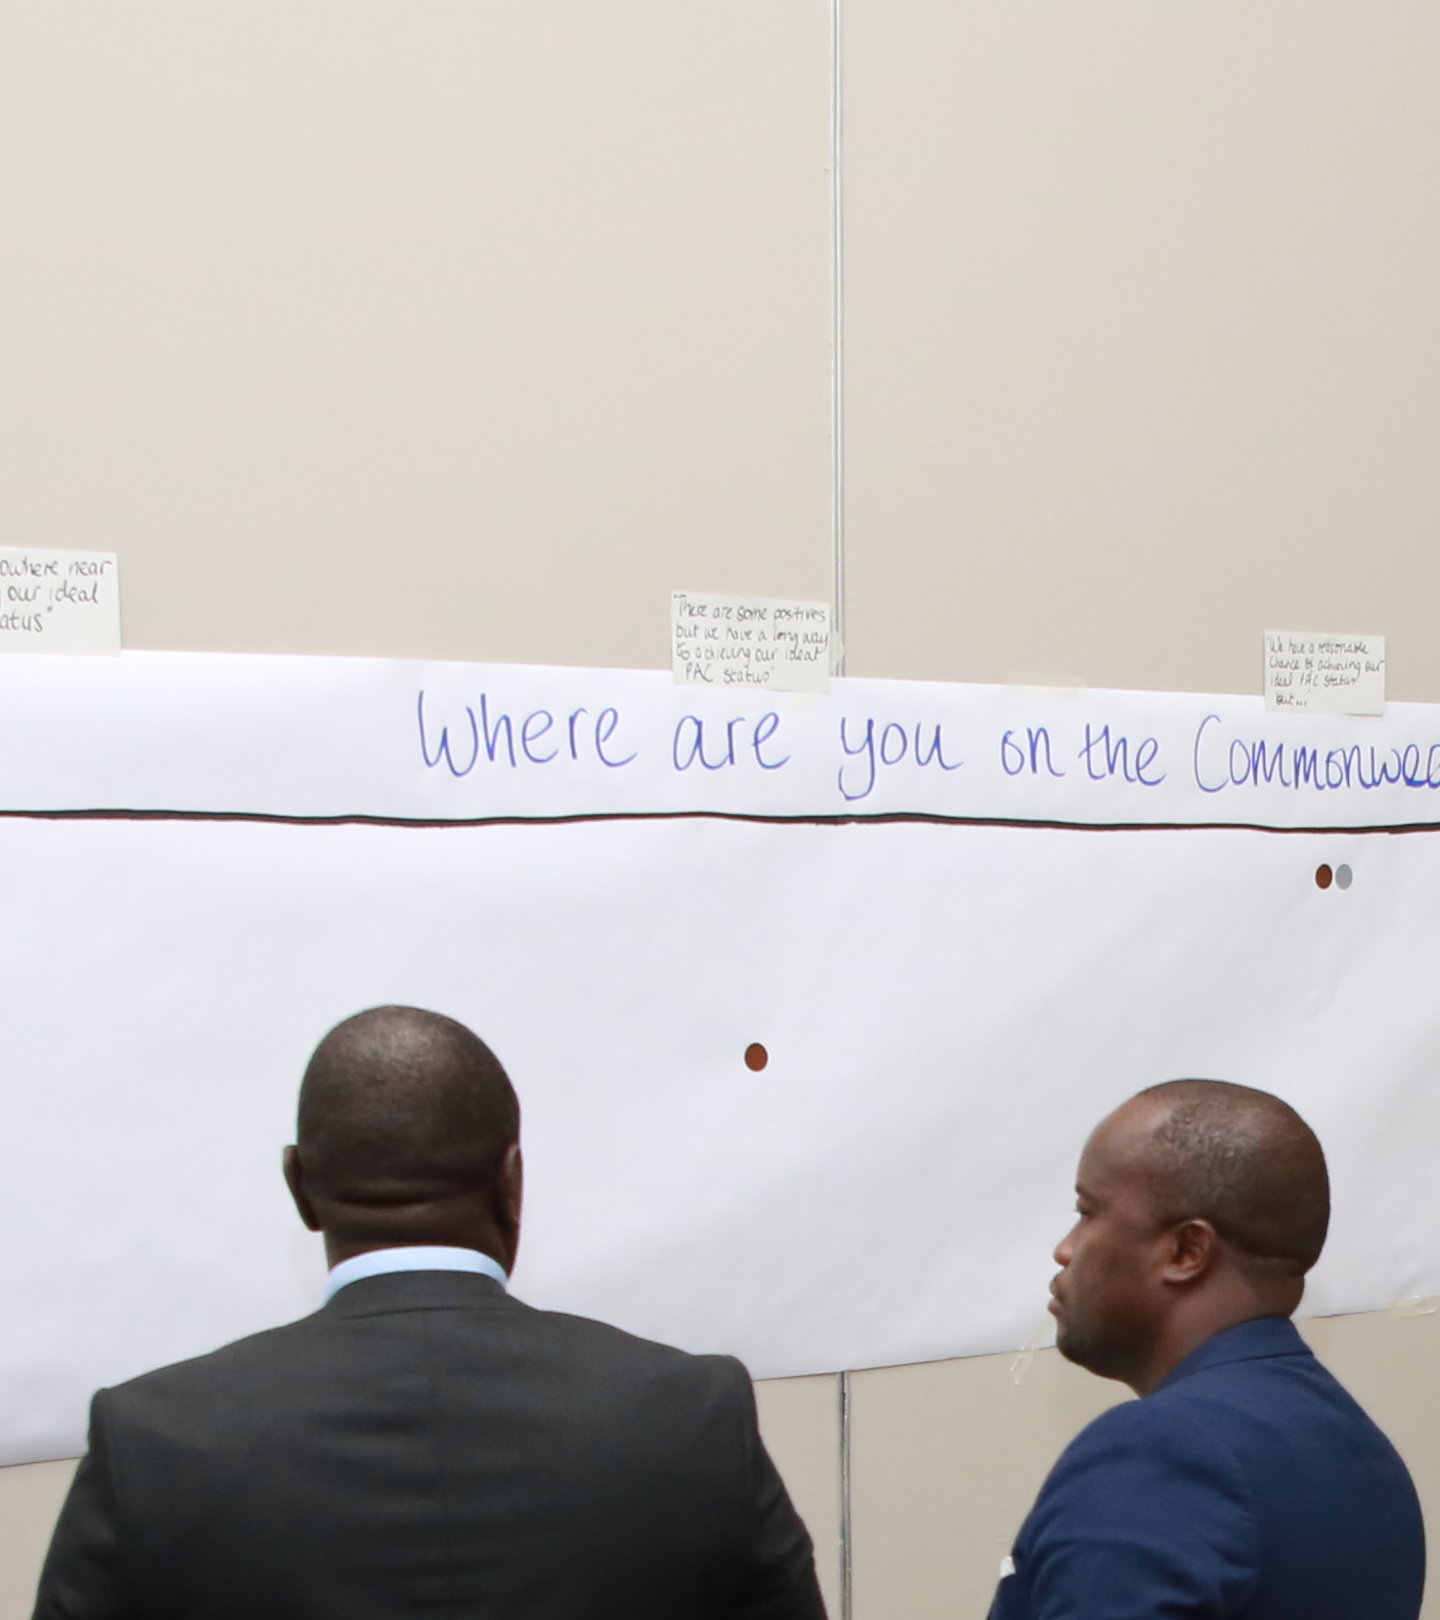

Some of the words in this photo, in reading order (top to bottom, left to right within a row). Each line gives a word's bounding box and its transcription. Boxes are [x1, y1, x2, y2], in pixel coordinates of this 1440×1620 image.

[68, 559, 113, 577] near
[7, 584, 42, 602] our
[49, 580, 101, 605] ideal
[713, 605, 733, 621] are
[737, 605, 768, 622] some
[675, 622, 699, 639] but
[758, 632, 768, 643] a
[685, 661, 714, 684] PAC
[417, 689, 638, 778] Where
[672, 710, 791, 771] are
[837, 714, 965, 801] you
[1000, 725, 1066, 777] on
[1076, 722, 1167, 787] the
